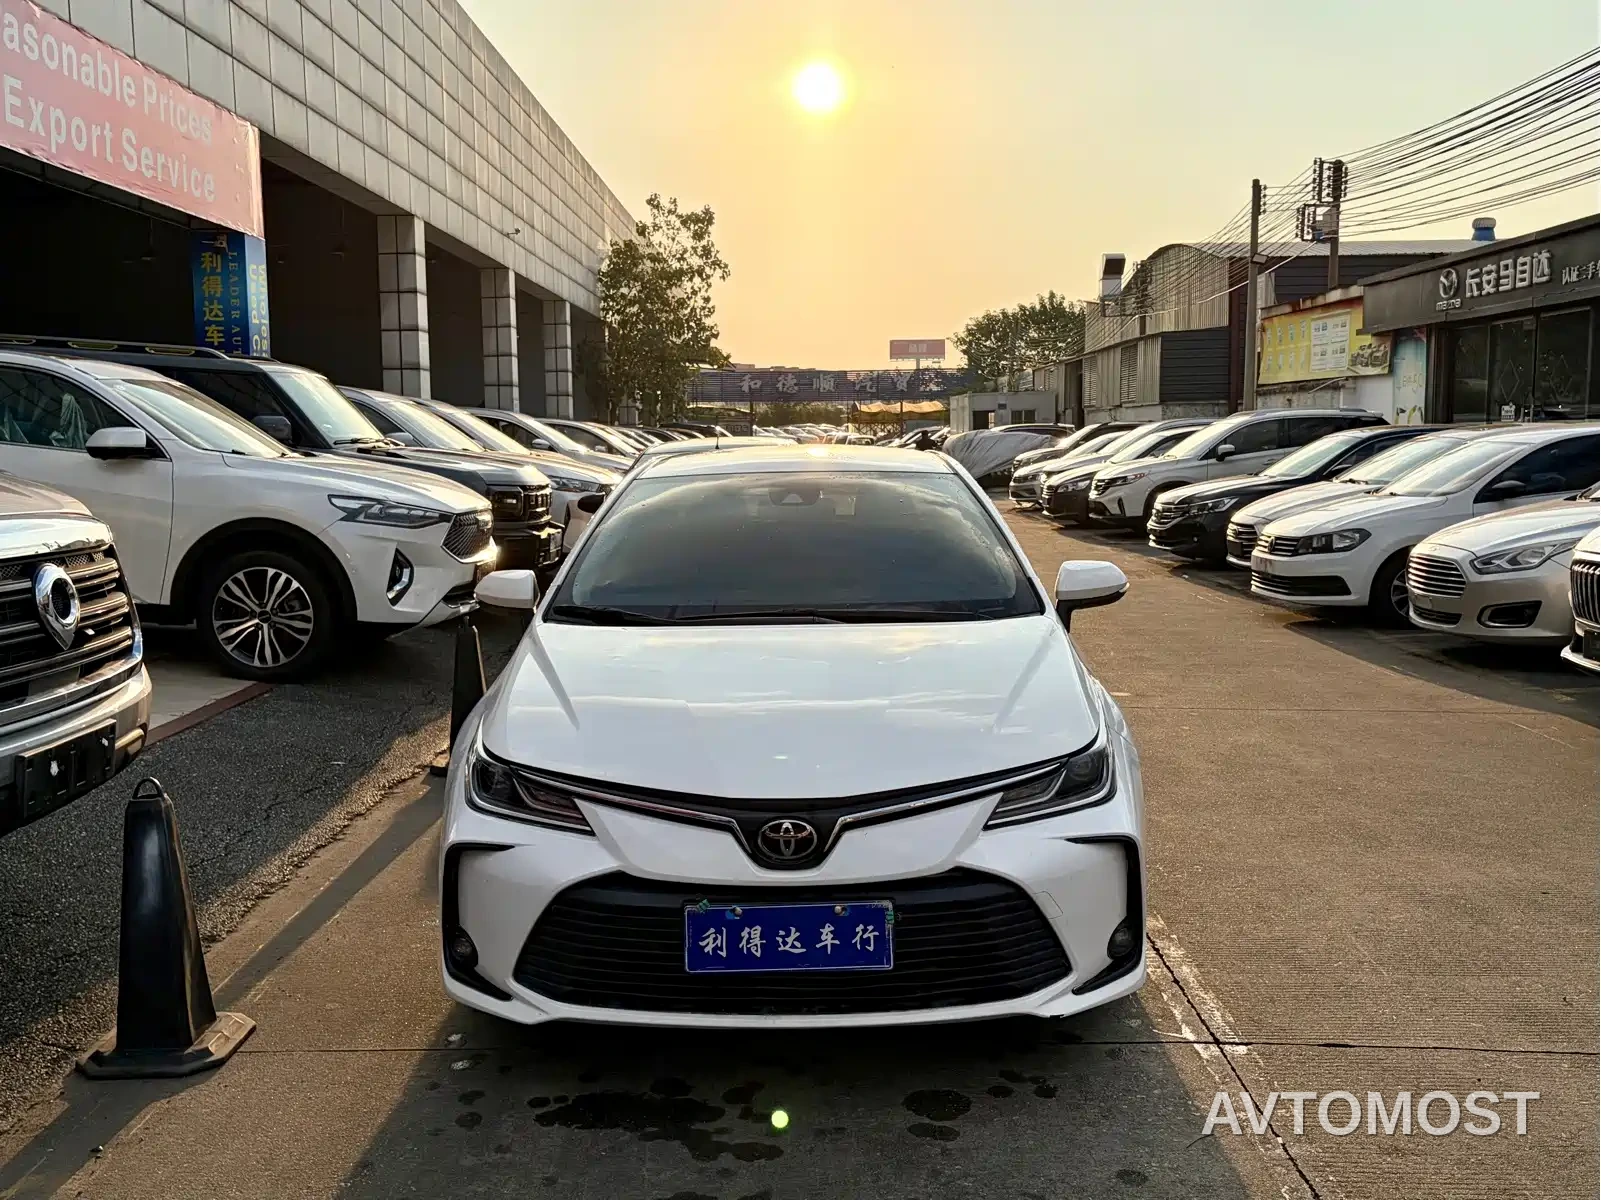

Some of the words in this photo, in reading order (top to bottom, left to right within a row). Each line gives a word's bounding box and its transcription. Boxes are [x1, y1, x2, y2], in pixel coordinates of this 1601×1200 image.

[3, 12, 137, 109] asonable
[142, 76, 213, 145] Prices
[3, 74, 114, 164] Export
[121, 127, 216, 202] Service
[200, 251, 225, 353] 利得达车
[228, 251, 240, 318] LEADER
[249, 264, 260, 324] Used
[1465, 250, 1551, 298] 长安马自达
[738, 371, 947, 392] 和德顺汽贸
[698, 923, 880, 958] 利得达车行
